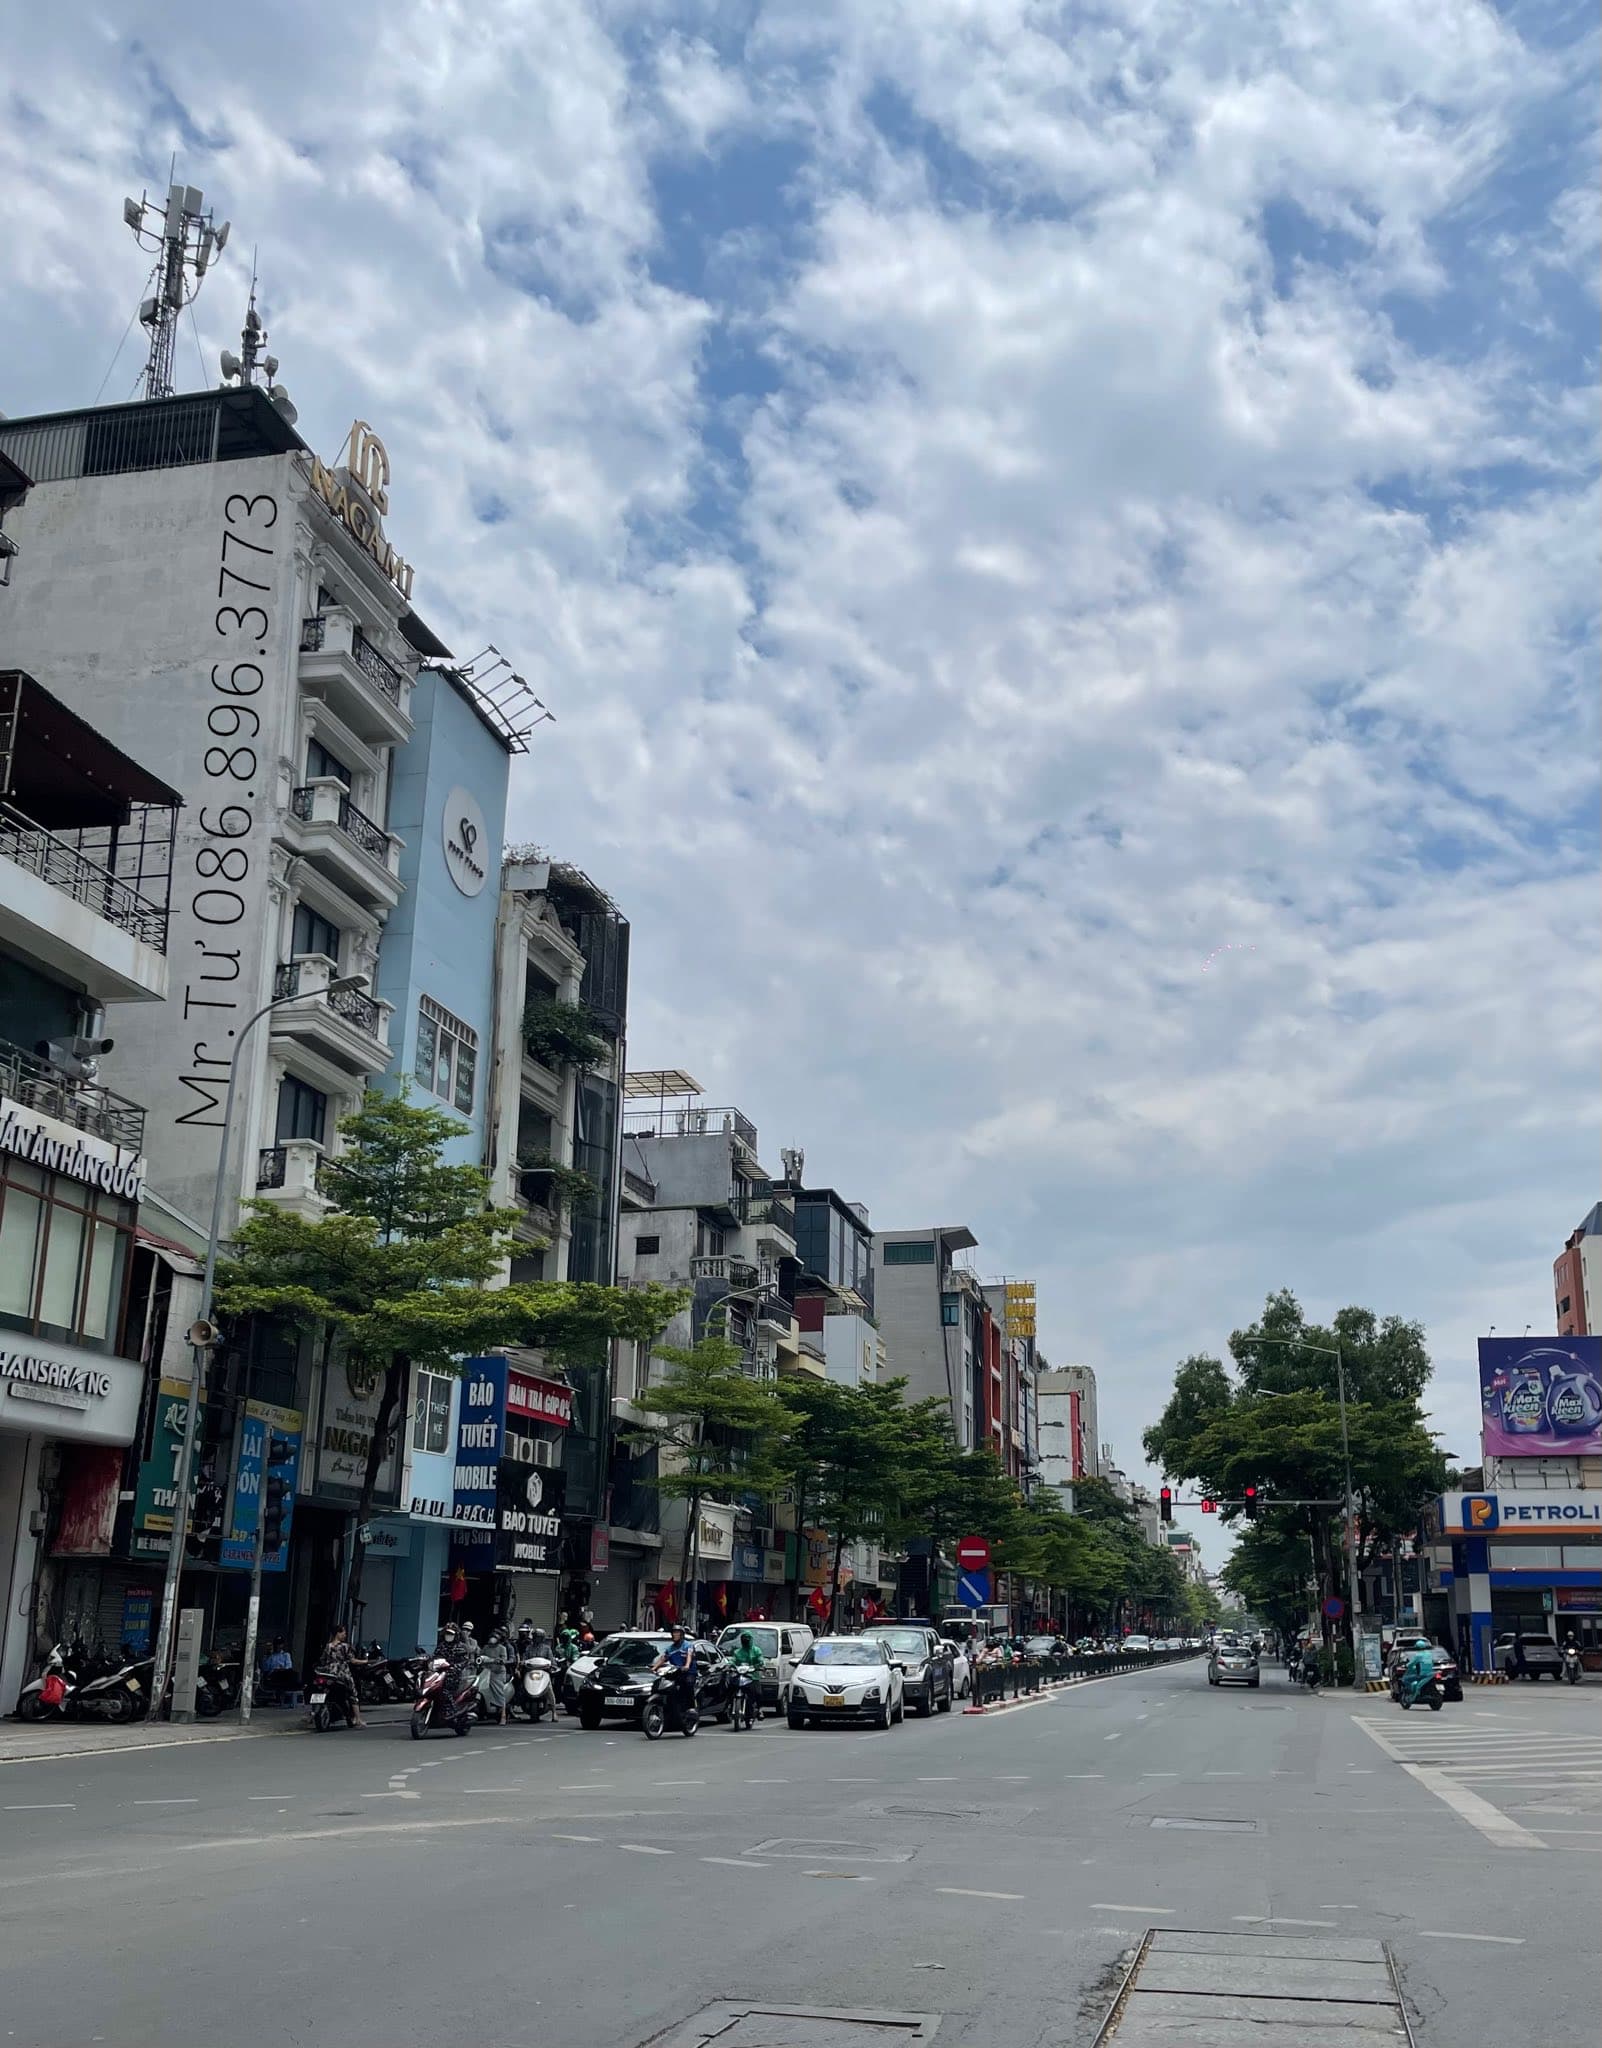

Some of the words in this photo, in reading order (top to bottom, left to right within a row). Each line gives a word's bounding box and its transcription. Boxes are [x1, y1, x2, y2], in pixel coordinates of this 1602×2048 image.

[310, 454, 415, 600] NAGAMI
[60, 1140, 101, 1184] HÀN
[468, 1373, 495, 1406] BẢO
[1513, 1394, 1540, 1404] Max
[1559, 1398, 1583, 1408] Max
[460, 1415, 498, 1448] TUYẾT
[454, 1465, 497, 1490] MOBILE
[502, 1504, 526, 1533] BẢO
[527, 1507, 561, 1536] TUYẾT
[1503, 1505, 1600, 1520] PETROLI
[514, 1543, 547, 1561] MOBILE
